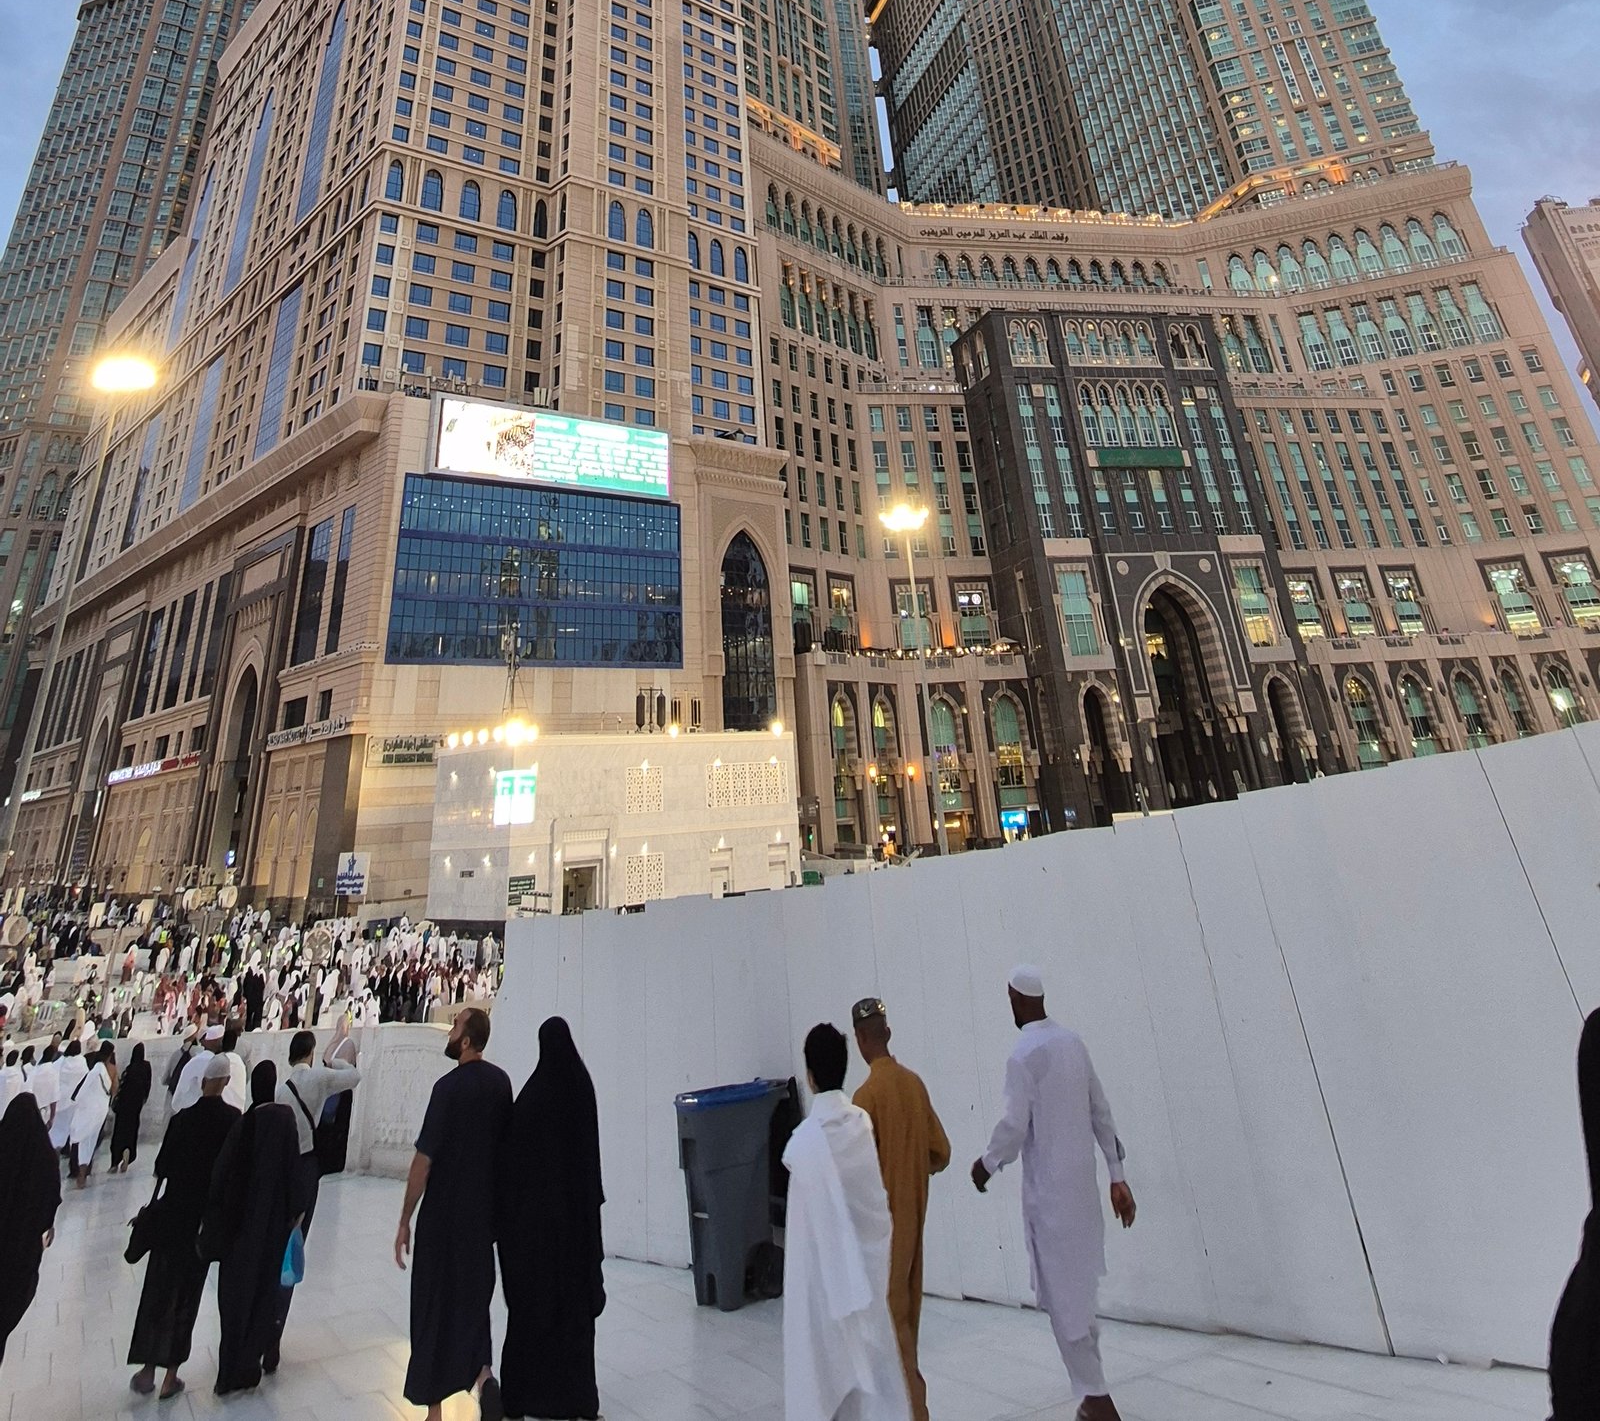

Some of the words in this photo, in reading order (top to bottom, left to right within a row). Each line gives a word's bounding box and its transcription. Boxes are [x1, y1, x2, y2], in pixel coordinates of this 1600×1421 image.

[919, 226, 954, 237] الشريفين
[956, 228, 985, 239] للحرمين
[988, 229, 1011, 240] العزيز
[1012, 231, 1026, 240] عبد
[1029, 230, 1048, 240] الملك
[1051, 232, 1069, 243] وقف
